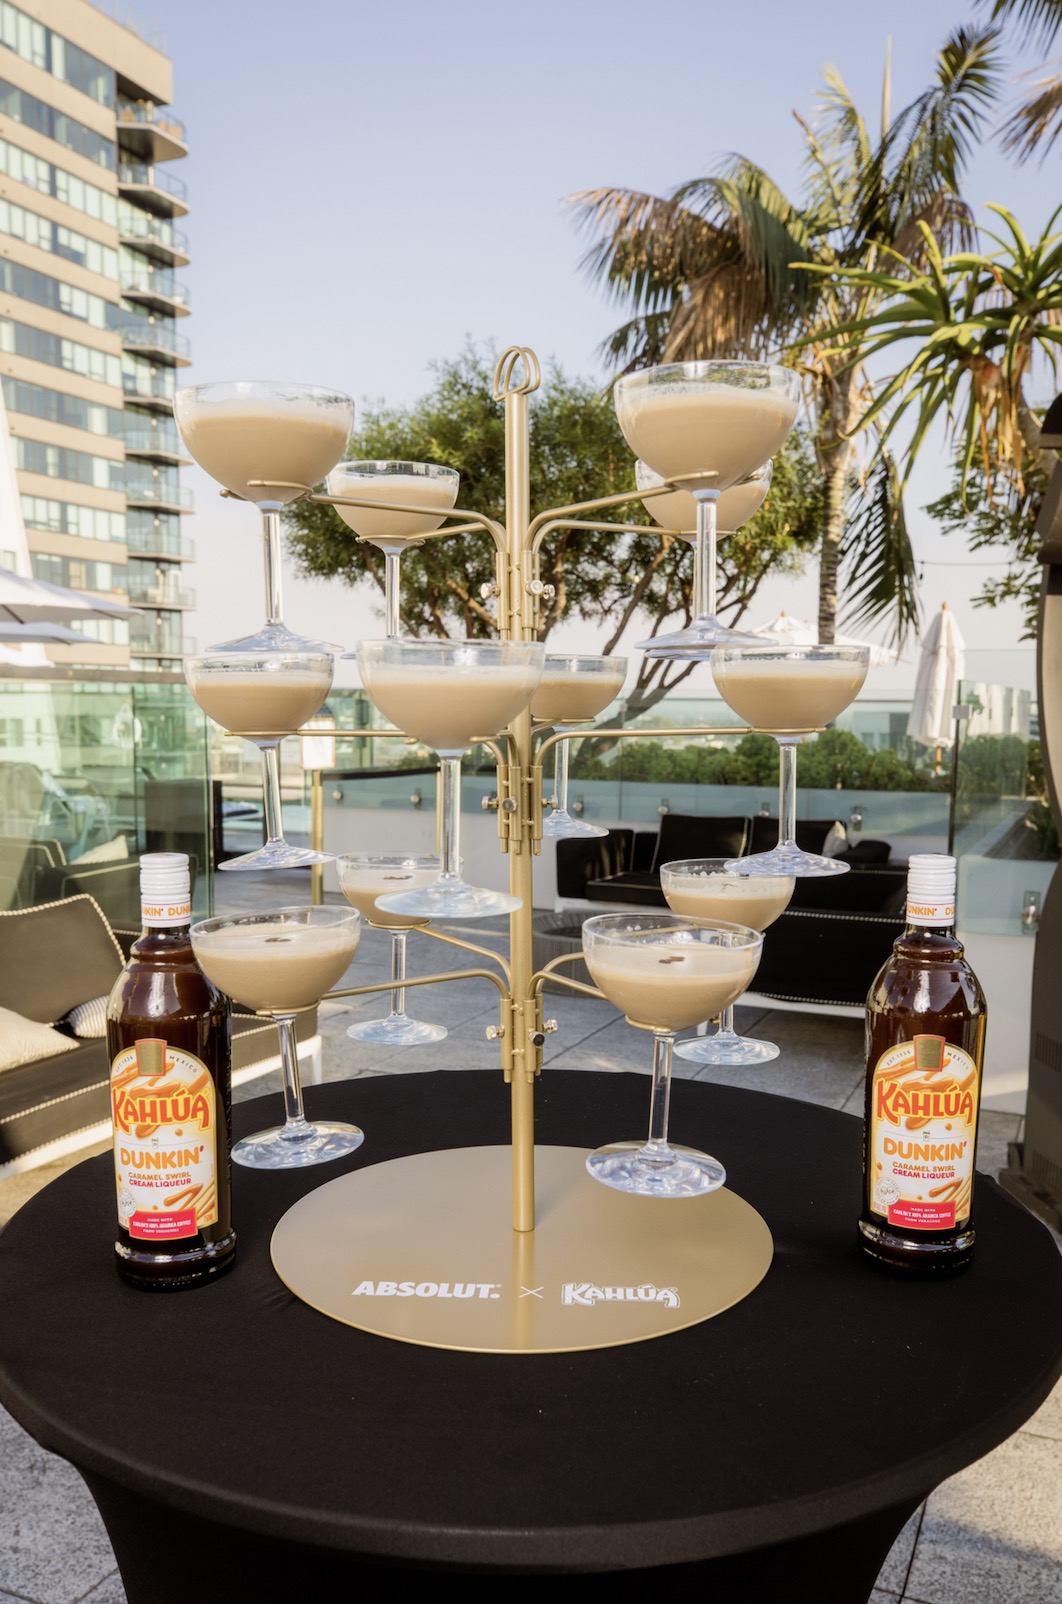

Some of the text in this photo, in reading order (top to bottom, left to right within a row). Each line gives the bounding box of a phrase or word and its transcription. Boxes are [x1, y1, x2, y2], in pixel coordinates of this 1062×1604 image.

[169, 1055, 198, 1073] MEXICO
[946, 1052, 970, 1071] MEXICO
[112, 1087, 210, 1134] KAHLÚA
[876, 1078, 973, 1126] KAHLÚA
[120, 1145, 204, 1170] DUNKIN'
[883, 1137, 967, 1162] DUNKIN'
[128, 1171, 191, 1181] CARAMEL SWIRL
[892, 1161, 955, 1173] CARAMEL SWIRL
[892, 1168, 955, 1179] CREAM LIQUEUR
[129, 1178, 191, 1188] CREAM LIQUEUR
[562, 1282, 680, 1308] KAHLÚA
